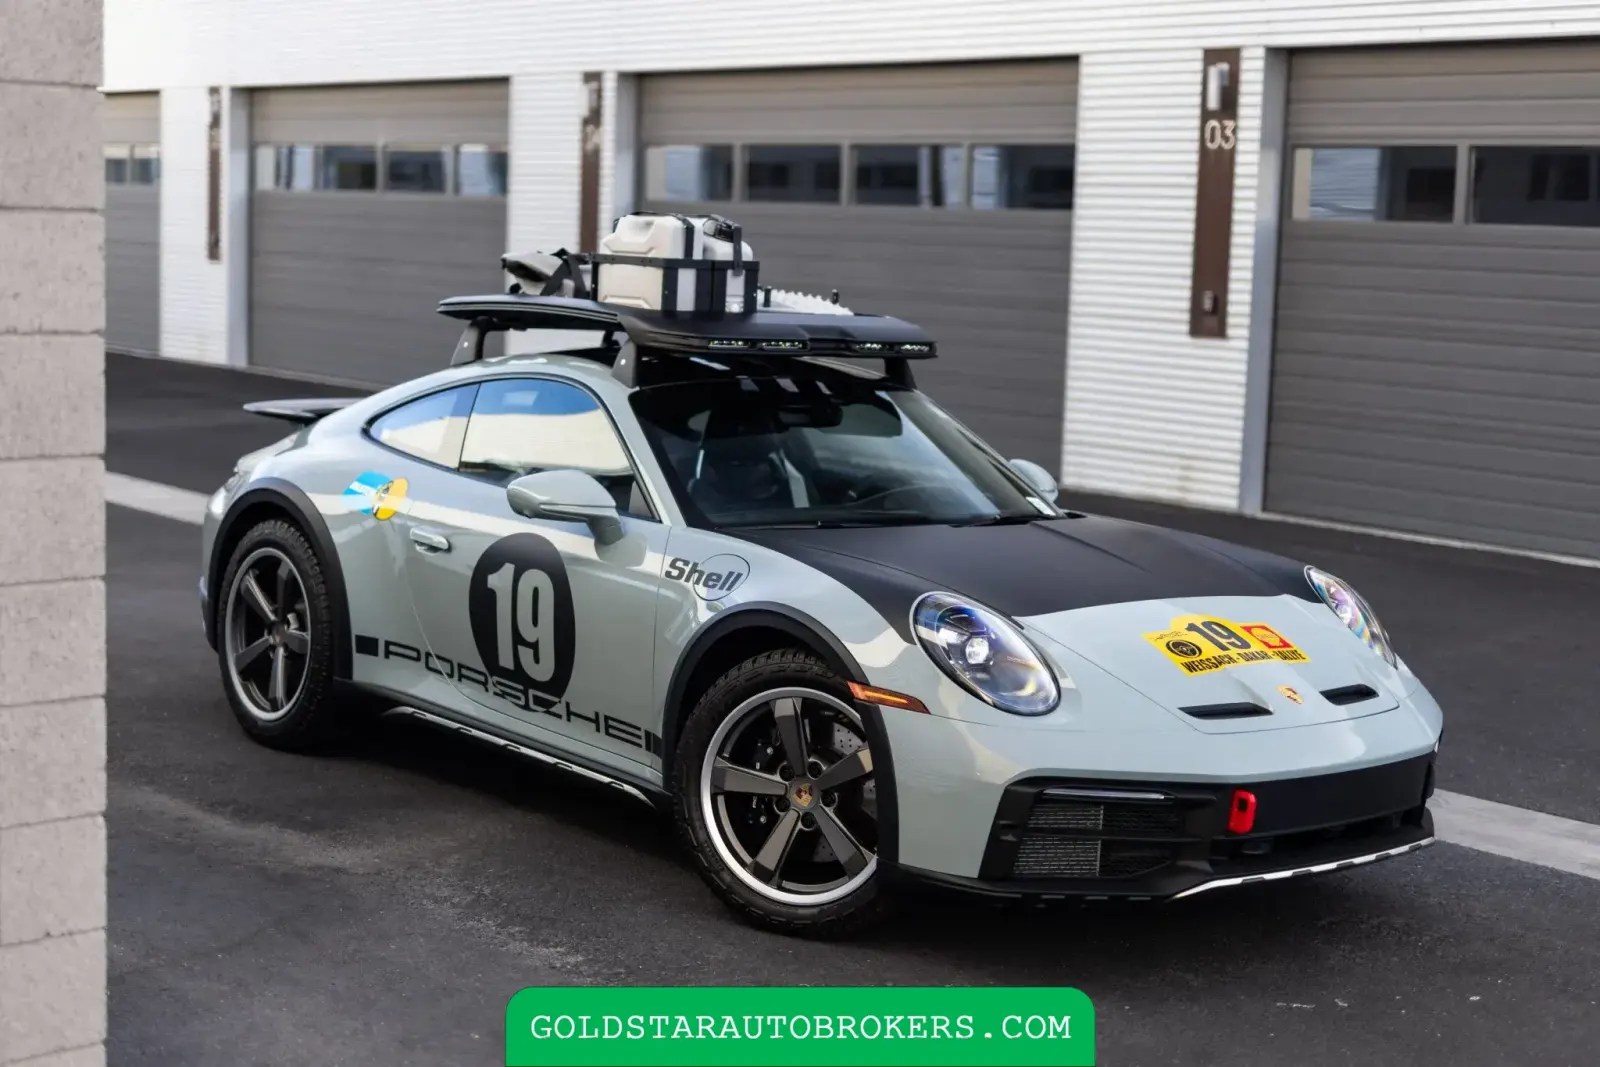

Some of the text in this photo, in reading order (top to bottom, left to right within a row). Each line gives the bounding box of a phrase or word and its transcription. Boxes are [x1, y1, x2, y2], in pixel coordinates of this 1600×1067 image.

[1204, 119, 1236, 149] 03
[664, 557, 744, 592] Shell
[486, 561, 555, 682] 19
[1184, 620, 1252, 651] 19
[1180, 653, 1237, 673] WEISSACH
[1240, 650, 1273, 662] DAKAR
[384, 639, 643, 749] PORSCHE
